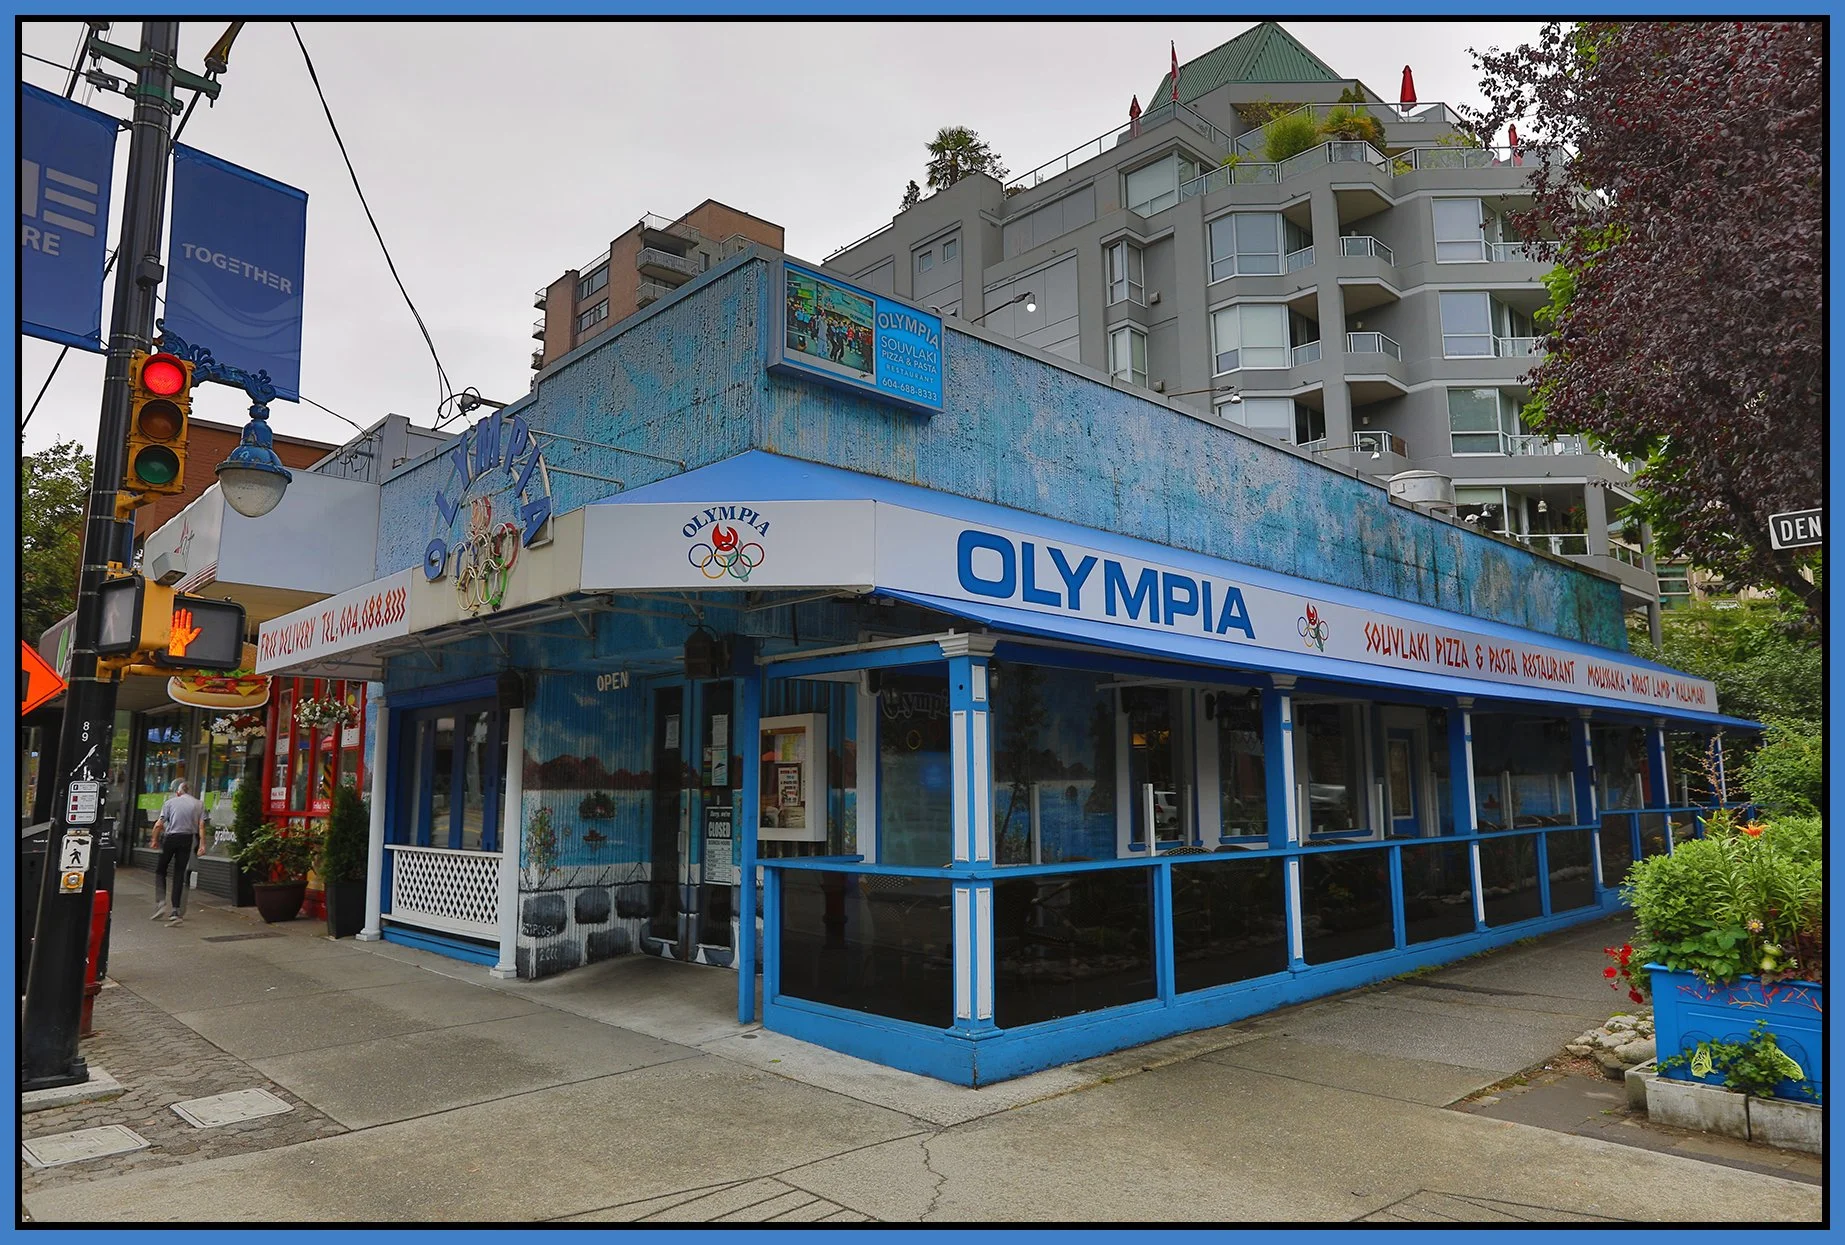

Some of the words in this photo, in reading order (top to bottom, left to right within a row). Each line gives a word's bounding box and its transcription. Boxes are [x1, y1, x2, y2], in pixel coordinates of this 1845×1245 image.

[182, 242, 293, 295] TOGETHER
[878, 312, 940, 350] OLYMPIA
[881, 335, 937, 365] SOUVLAKI
[881, 349, 905, 365] PIZZA
[906, 357, 912, 367] &
[913, 360, 937, 375] PASTA
[886, 363, 934, 385] RESTAURANT
[882, 378, 938, 402] 604-688-8333
[682, 505, 771, 538] OLYMPIA
[1780, 515, 1822, 542] DEN
[957, 529, 1256, 640] OLYMPIA
[259, 630, 278, 663] FREE
[278, 616, 317, 657] DELIVERY
[1364, 621, 1430, 663] SOUVLAKI
[1435, 635, 1470, 669] PIZZA
[1475, 643, 1484, 671] &
[1488, 646, 1519, 676] PASTA
[1522, 651, 1576, 685] RESTAURANT
[1587, 665, 1627, 693] MOUSSAKA
[1631, 671, 1651, 697] ROAST
[1652, 675, 1671, 700] LAMB
[1675, 681, 1707, 705] KALAMARI
[597, 671, 629, 692] OPEN
[708, 821, 731, 838] CLOSED
